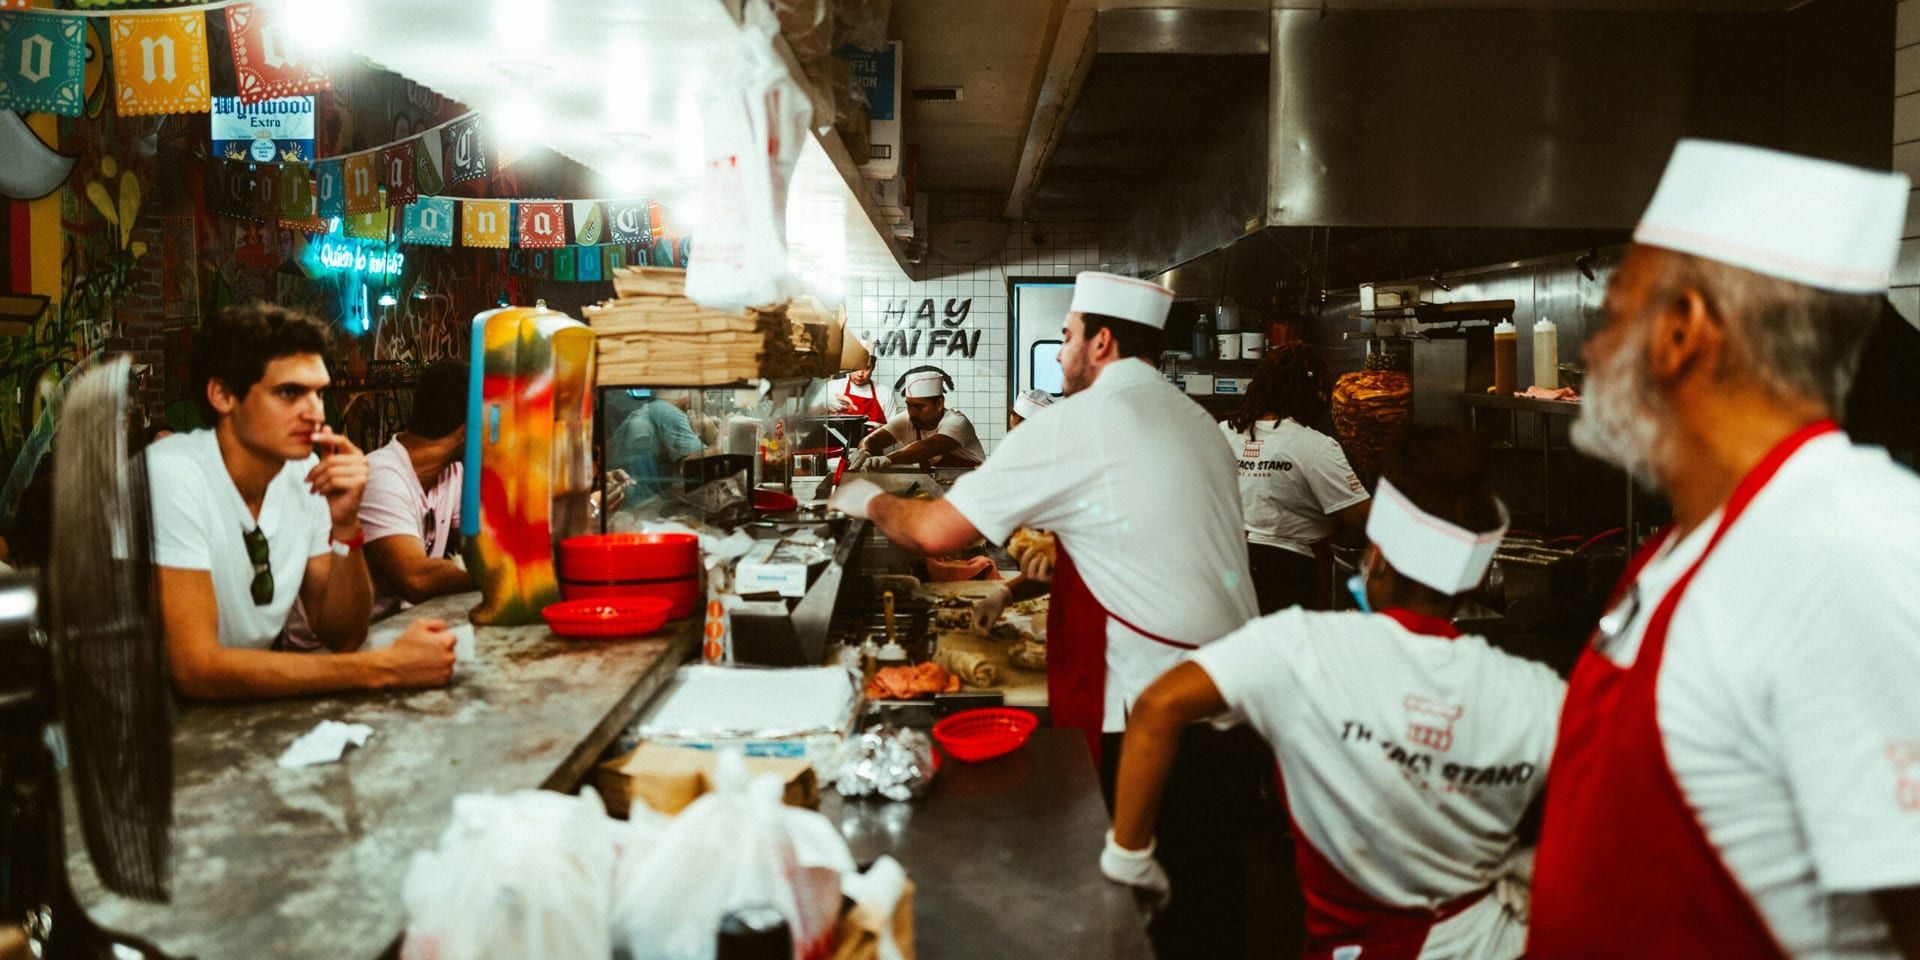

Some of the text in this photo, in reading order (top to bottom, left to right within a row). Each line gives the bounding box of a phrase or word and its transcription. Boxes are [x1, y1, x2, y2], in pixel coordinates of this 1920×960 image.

[214, 96, 312, 119] Wynwood
[250, 117, 281, 127] Extra
[354, 245, 367, 270] lo
[882, 298, 972, 329] HAY
[927, 329, 981, 358] FAI
[1257, 460, 1293, 472] STAND
